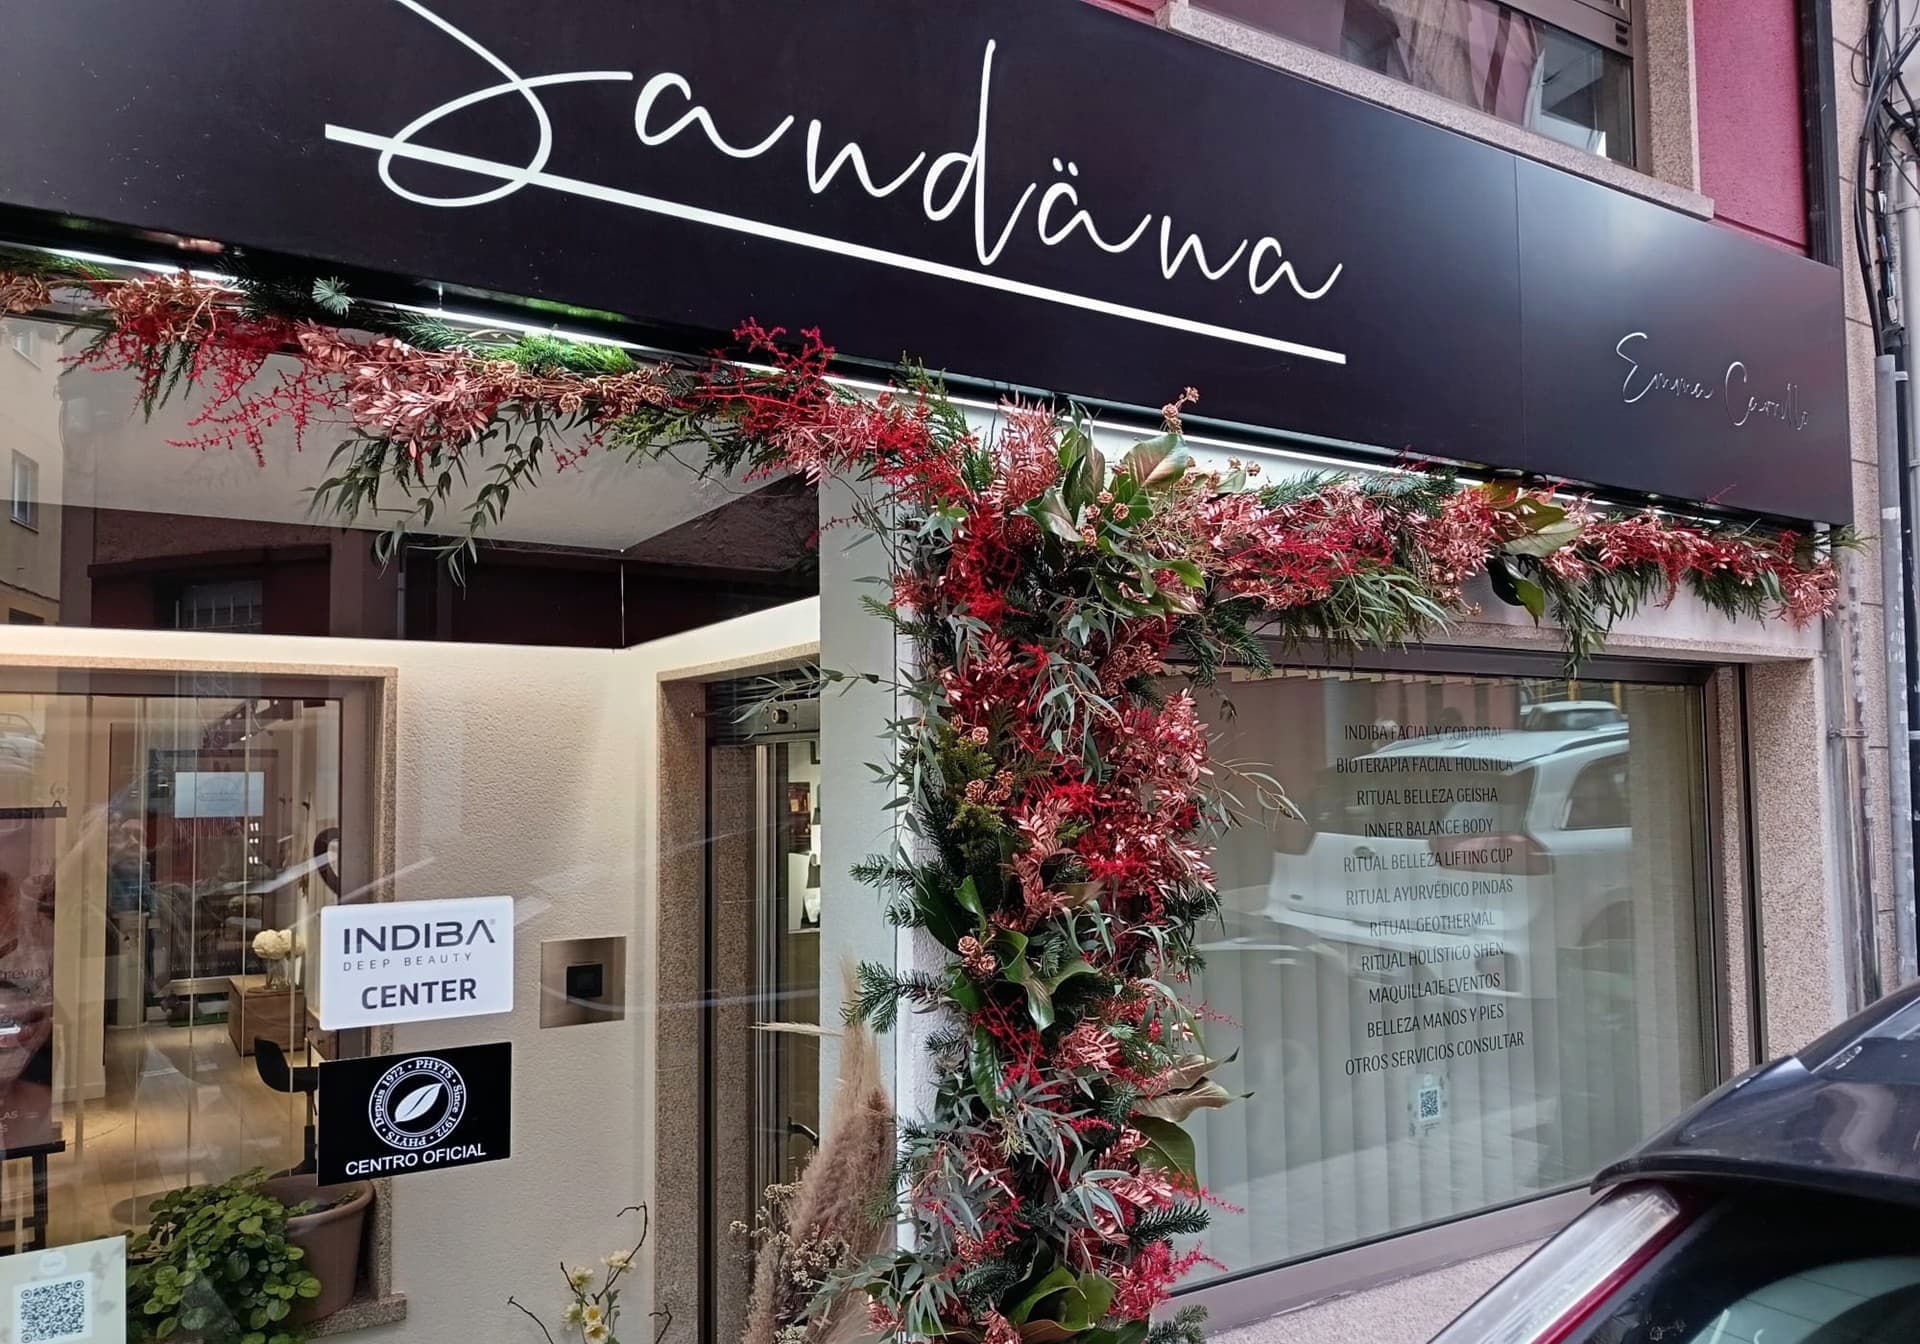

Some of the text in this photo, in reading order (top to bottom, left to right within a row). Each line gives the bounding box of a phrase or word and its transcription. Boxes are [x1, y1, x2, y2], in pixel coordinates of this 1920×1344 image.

[1344, 725, 1389, 741] INDIBA
[1391, 726, 1434, 741] FACIAL
[1336, 757, 1410, 774] BIOTERAPIA
[1412, 757, 1453, 772] FACIAL
[1357, 787, 1499, 806] RITUAL BELLEZA GEISHA
[1364, 818, 1494, 838] INNER BALANCE BODY
[1344, 848, 1513, 873] RITUAL BELLEZA LIFTING CUP
[1346, 878, 1513, 906] RITUAL AYURVÉDICO PINDAS
[343, 919, 496, 955] INDIBA
[1369, 910, 1496, 938] RITUAL GEOTHERMAL
[343, 951, 473, 972] DEEP BEAUTY
[1361, 941, 1504, 972] RITUAL HOLÍSTICO SHEN
[361, 977, 478, 1010] CENTER
[1368, 972, 1501, 1005] MAQUILLAJE EVENTOS
[1367, 1003, 1504, 1039] BELLEZA MANOS Y PIES
[1345, 1031, 1525, 1076] OTROS SERVICIOS CONSULTAR
[374, 1066, 427, 1147] PHYTS Depuis 1972
[415, 1059, 464, 1137] PHYTS Since 1972
[345, 1142, 488, 1176] CENTRO OFICIAL
